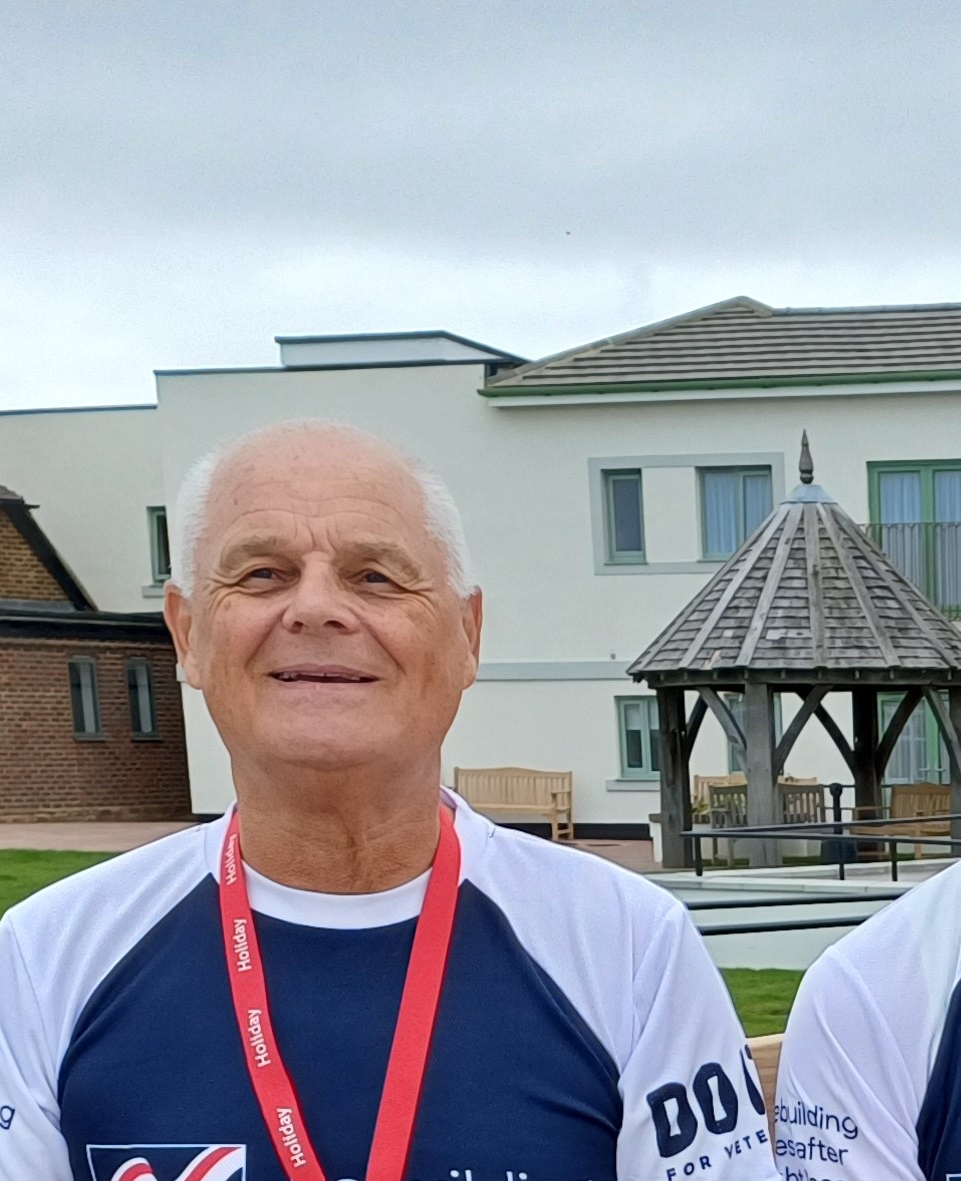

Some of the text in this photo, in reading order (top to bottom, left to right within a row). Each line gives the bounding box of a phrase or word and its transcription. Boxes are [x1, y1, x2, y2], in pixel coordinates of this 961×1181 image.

[233, 919, 252, 972] Holiday
[248, 1010, 271, 1067] Holiday
[277, 1107, 306, 1167] Holiday
[795, 1136, 849, 1165] after
[666, 1155, 712, 1181] FOR
